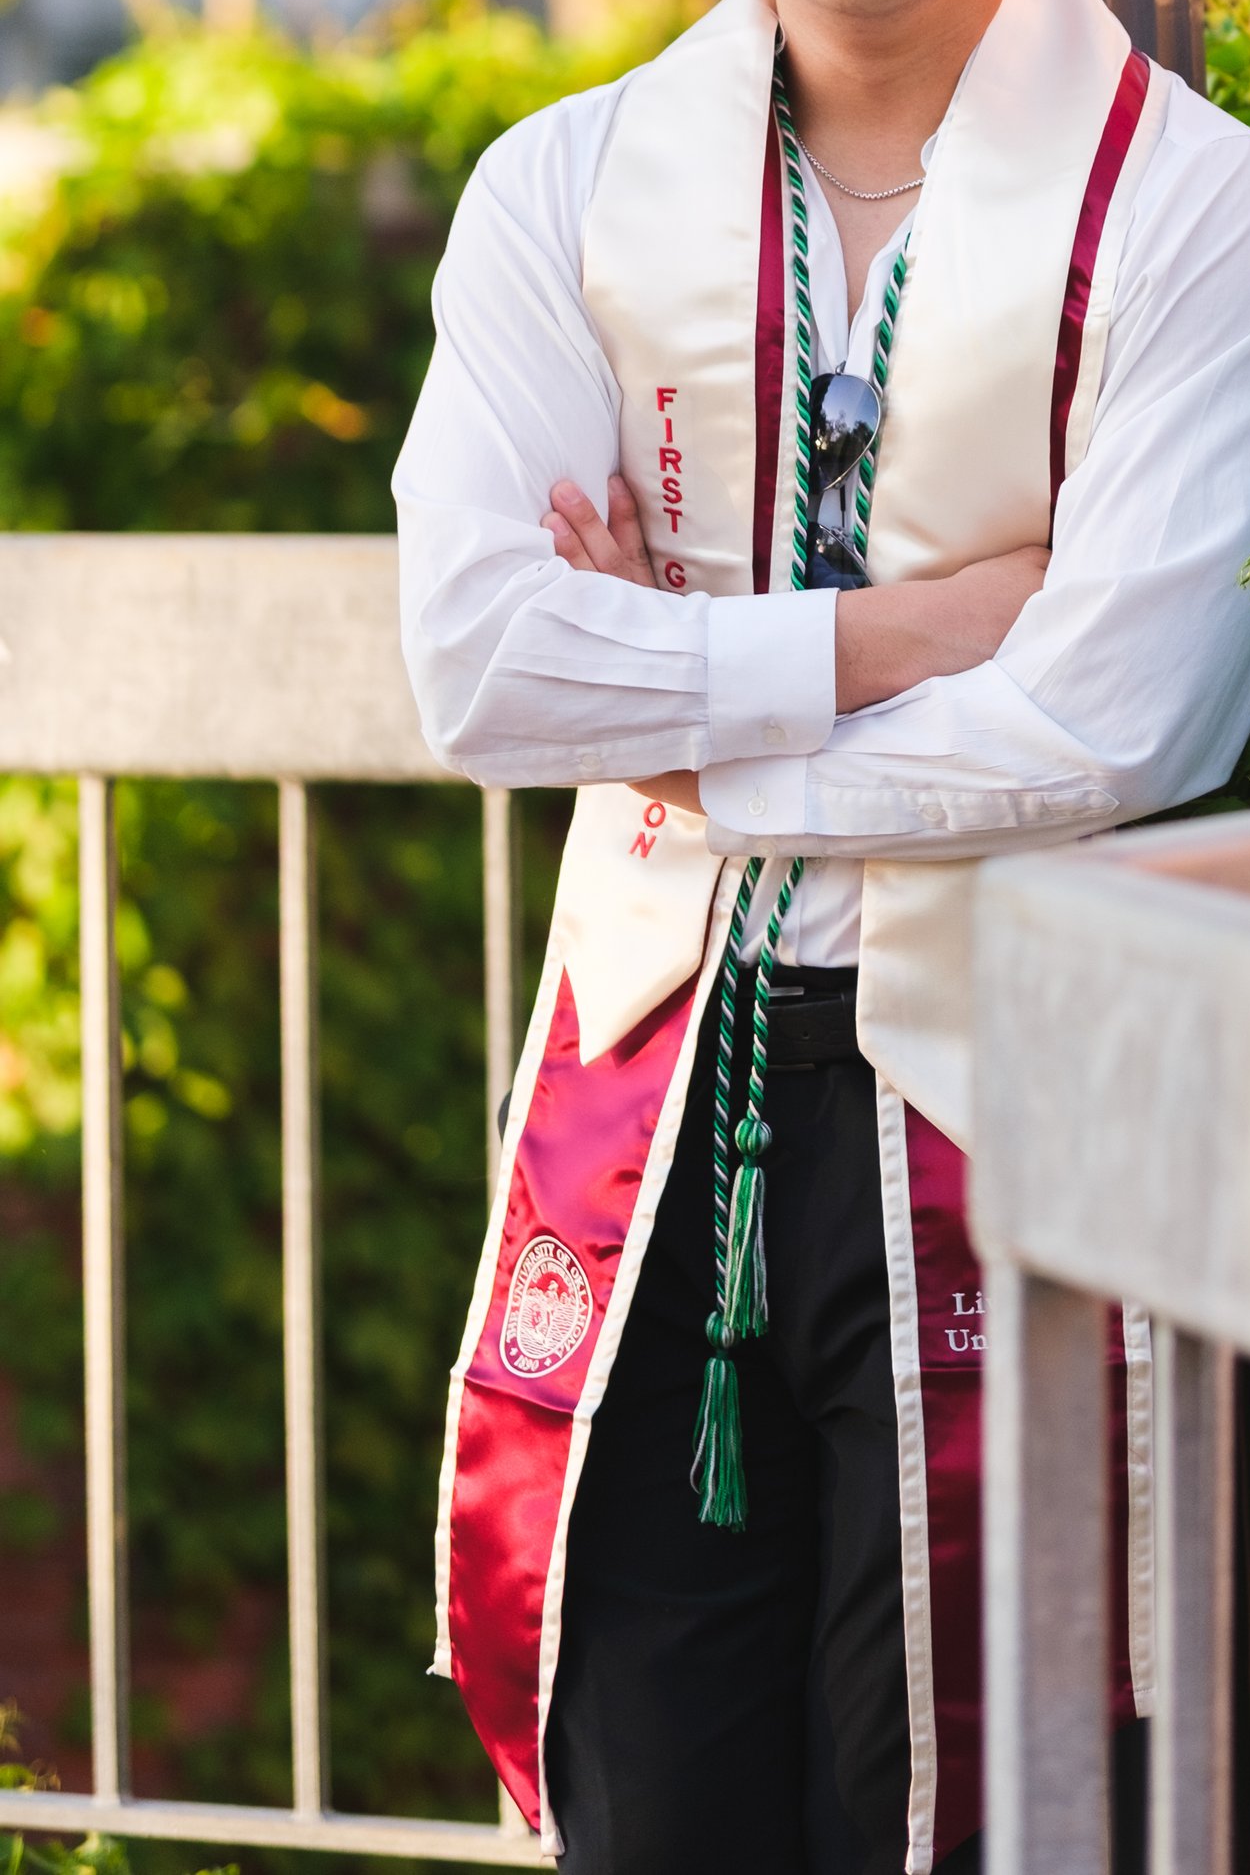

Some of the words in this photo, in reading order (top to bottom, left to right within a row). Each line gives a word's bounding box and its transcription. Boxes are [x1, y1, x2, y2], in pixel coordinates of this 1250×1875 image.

[656, 387, 683, 533] FIRST
[556, 1248, 571, 1268] OF
[512, 1243, 555, 1307] UNIVERSITY
[555, 1266, 588, 1358] OKLAHOMA
[952, 1291, 990, 1316] Li
[506, 1310, 519, 1343] THE
[944, 1329, 990, 1351] Un
